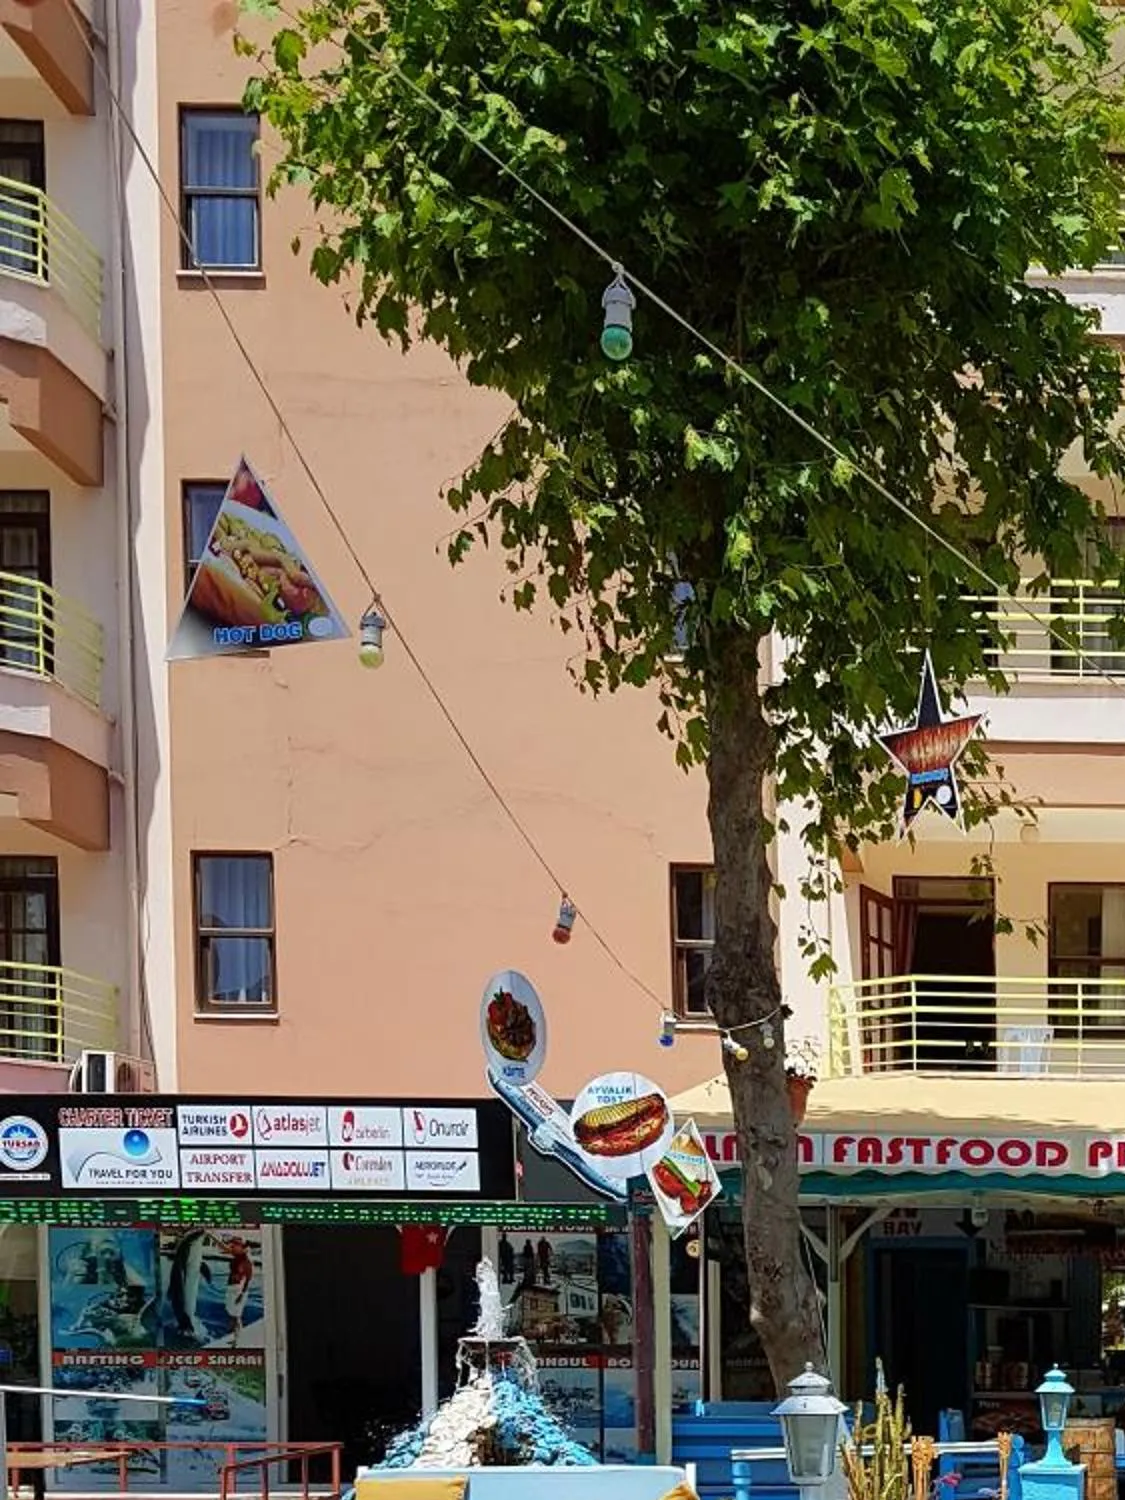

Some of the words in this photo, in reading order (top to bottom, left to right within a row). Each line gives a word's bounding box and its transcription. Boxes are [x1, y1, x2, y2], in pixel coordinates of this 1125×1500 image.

[213, 627, 255, 644] HOT
[259, 623, 302, 640] DOG
[587, 1086, 632, 1096] AYVALIK
[597, 1096, 623, 1104] TOST
[58, 1107, 123, 1127] CHARTER
[124, 1107, 174, 1127] TICKET
[182, 1114, 227, 1124] TURKISH
[273, 1113, 321, 1135] atlasjet
[182, 1125, 228, 1136] AIRLINES
[833, 1136, 1069, 1167] FASTFOOD
[190, 1153, 246, 1165] AIRPORT
[88, 1168, 124, 1179] TRAVEL
[125, 1168, 147, 1179] FOR
[149, 1168, 173, 1179] YOU
[186, 1171, 253, 1184] TRANSFER
[63, 1354, 145, 1365] RAFTING
